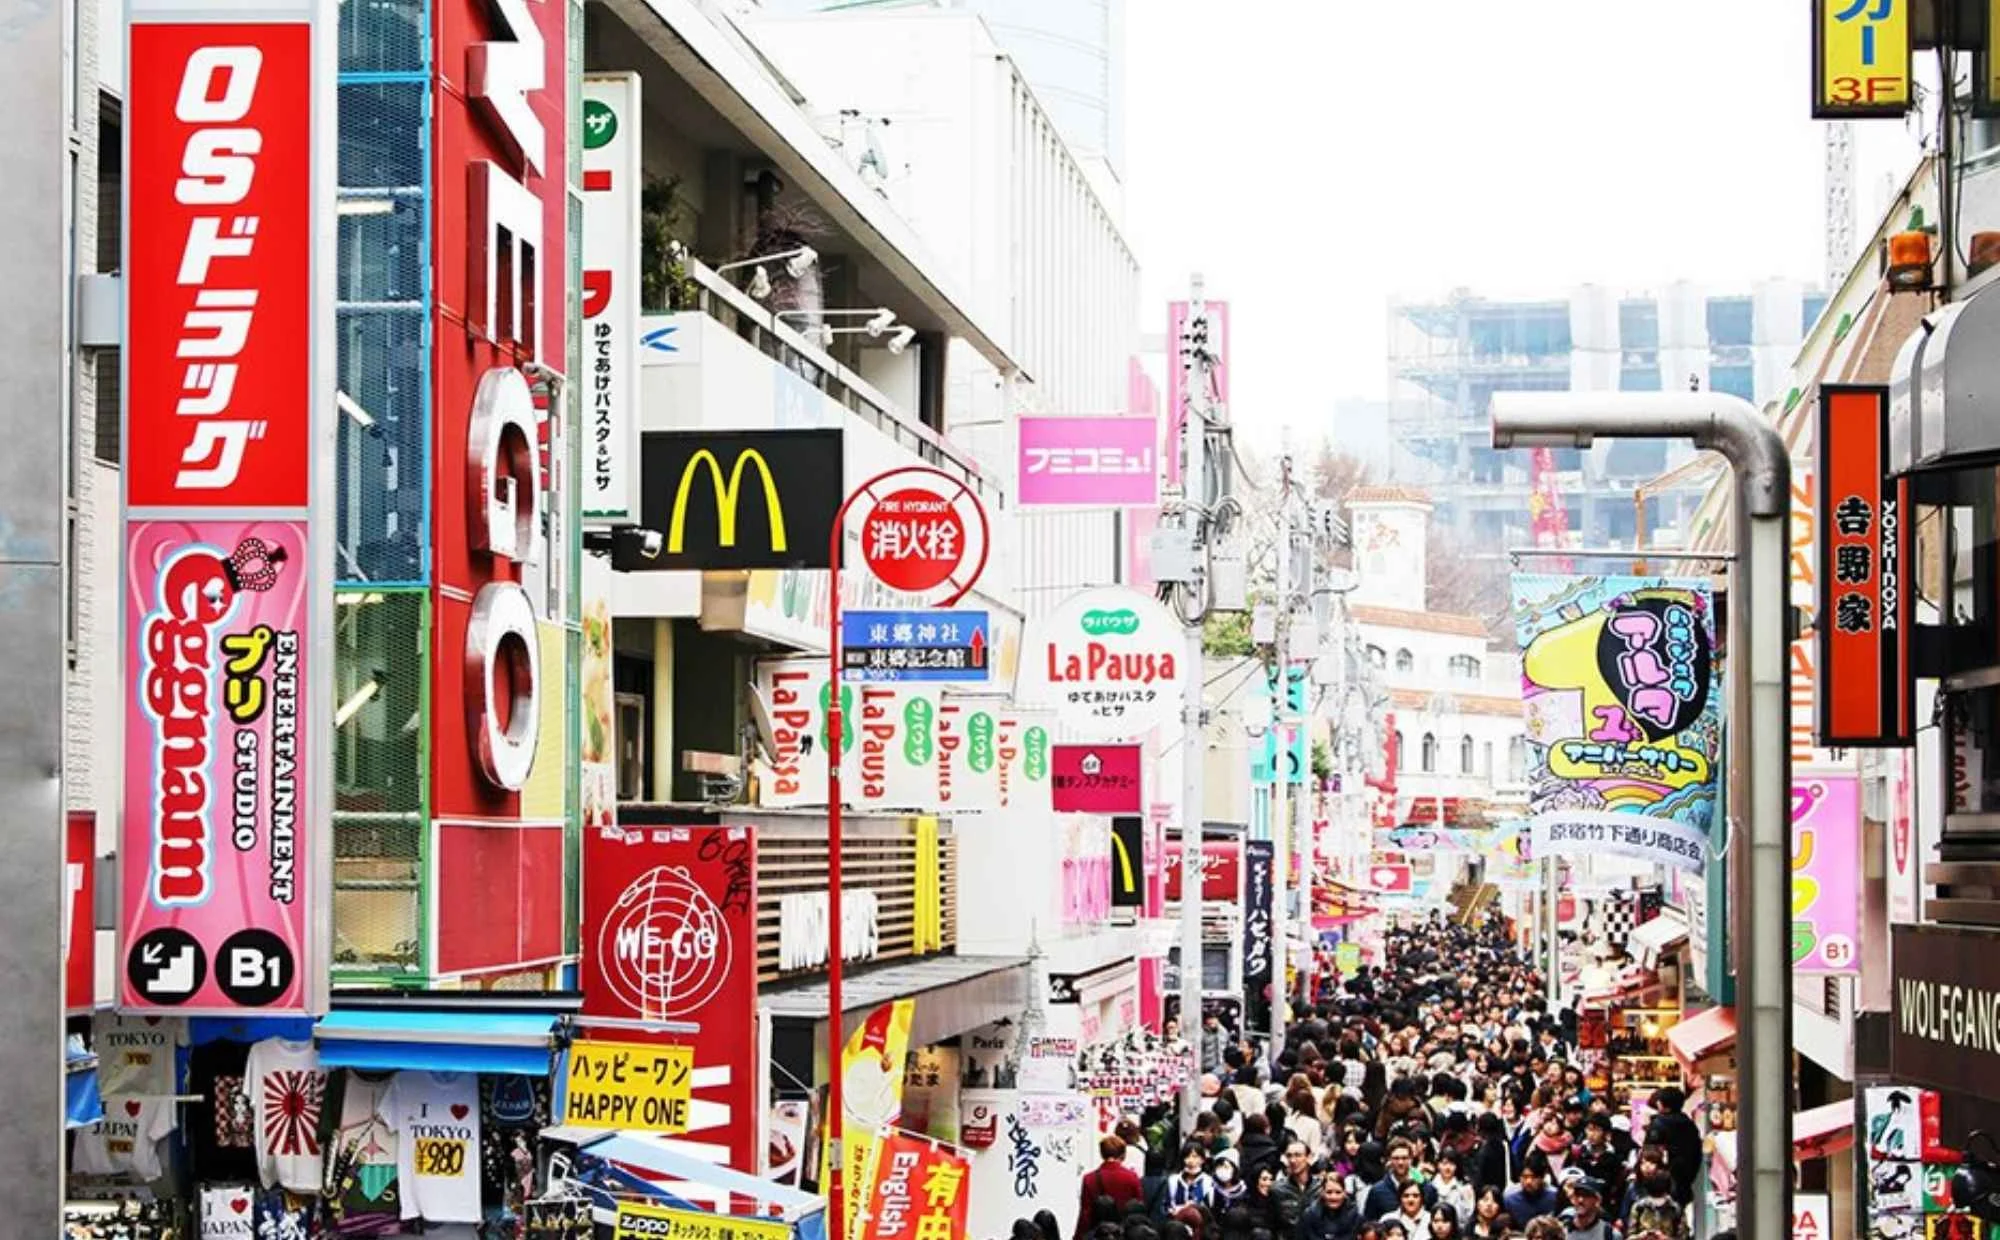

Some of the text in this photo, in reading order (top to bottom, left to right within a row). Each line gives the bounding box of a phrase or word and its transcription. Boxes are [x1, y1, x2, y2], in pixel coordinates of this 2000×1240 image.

[1831, 77, 1902, 101] 3F
[174, 45, 268, 489] OSドラッグ
[879, 500, 950, 513] FIRE HYDRANT
[870, 519, 958, 560] 消火栓
[1836, 497, 1873, 633] 吉野家
[1882, 501, 1897, 630] YOSHINOYA
[869, 623, 960, 643] 東郷神社
[870, 648, 965, 668] 東郷記念館
[147, 551, 236, 900] eggnam
[224, 626, 270, 850] プリ STUDIO
[272, 631, 298, 903] ENTERTAINMENT
[1549, 822, 1704, 860] 原宿竹下通り商店会
[230, 950, 281, 986] B1
[1826, 943, 1849, 959] B1
[1899, 975, 2000, 1055] WOLFGANG
[105, 1032, 166, 1047] TOKYO
[973, 1036, 1005, 1048] Paris
[571, 1053, 689, 1086] ハッピーワン
[420, 1103, 428, 1118] I
[567, 1091, 686, 1126] HAPPY ONE
[410, 1124, 472, 1139] TOKYO
[415, 1141, 466, 1175] ¥980
[876, 1151, 920, 1236] English
[201, 1221, 252, 1237] JAPAN
